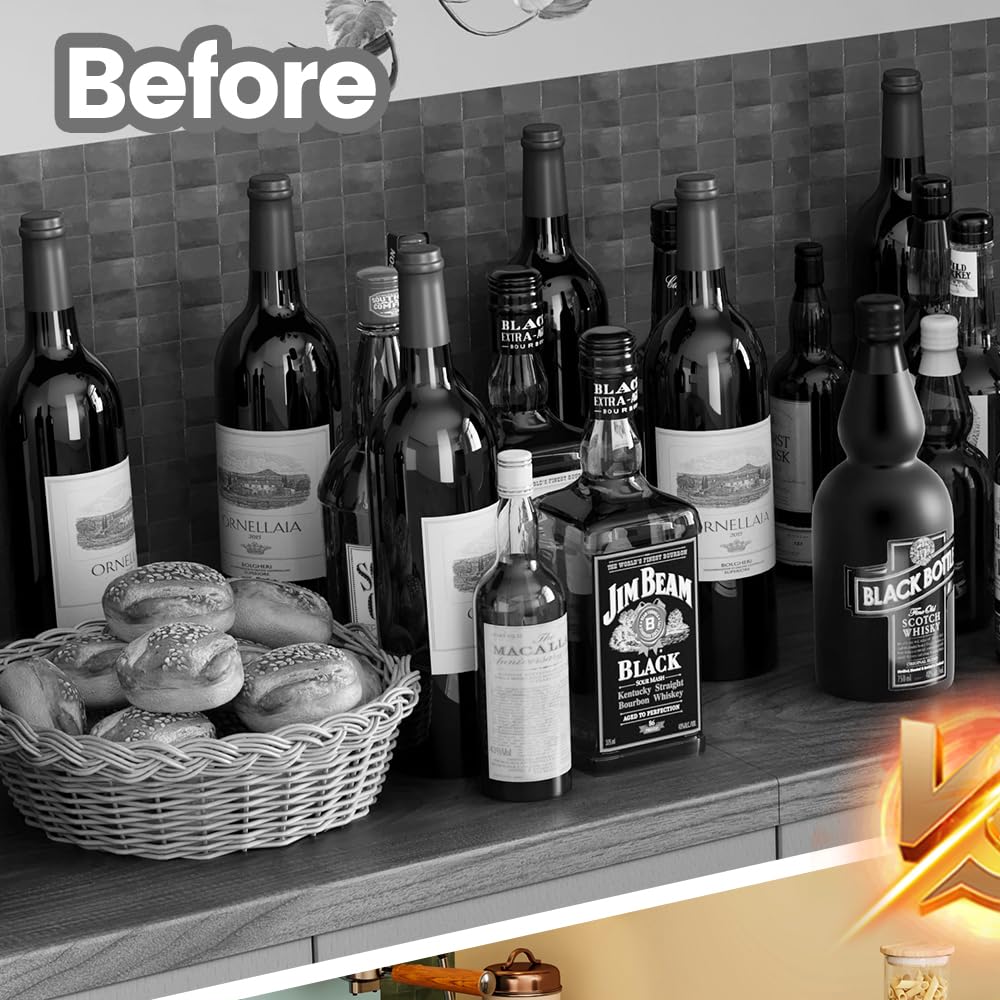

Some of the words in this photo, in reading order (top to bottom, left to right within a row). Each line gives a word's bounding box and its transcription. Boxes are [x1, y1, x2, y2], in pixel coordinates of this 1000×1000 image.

[603, 577, 641, 627] JIM
[640, 566, 693, 609] BEAM
[862, 572, 922, 606] BLACK
[645, 616, 656, 631] B
[902, 611, 941, 628] SCOTCH
[902, 621, 941, 638] WHISKY
[617, 651, 682, 681] BLACK
[618, 686, 652, 700] Kentucky
[655, 679, 684, 693] Straight
[618, 697, 650, 710] Bourbon
[653, 690, 684, 702] Whiskey
[623, 713, 638, 722] AGED
[646, 704, 681, 717] PERFECTION
